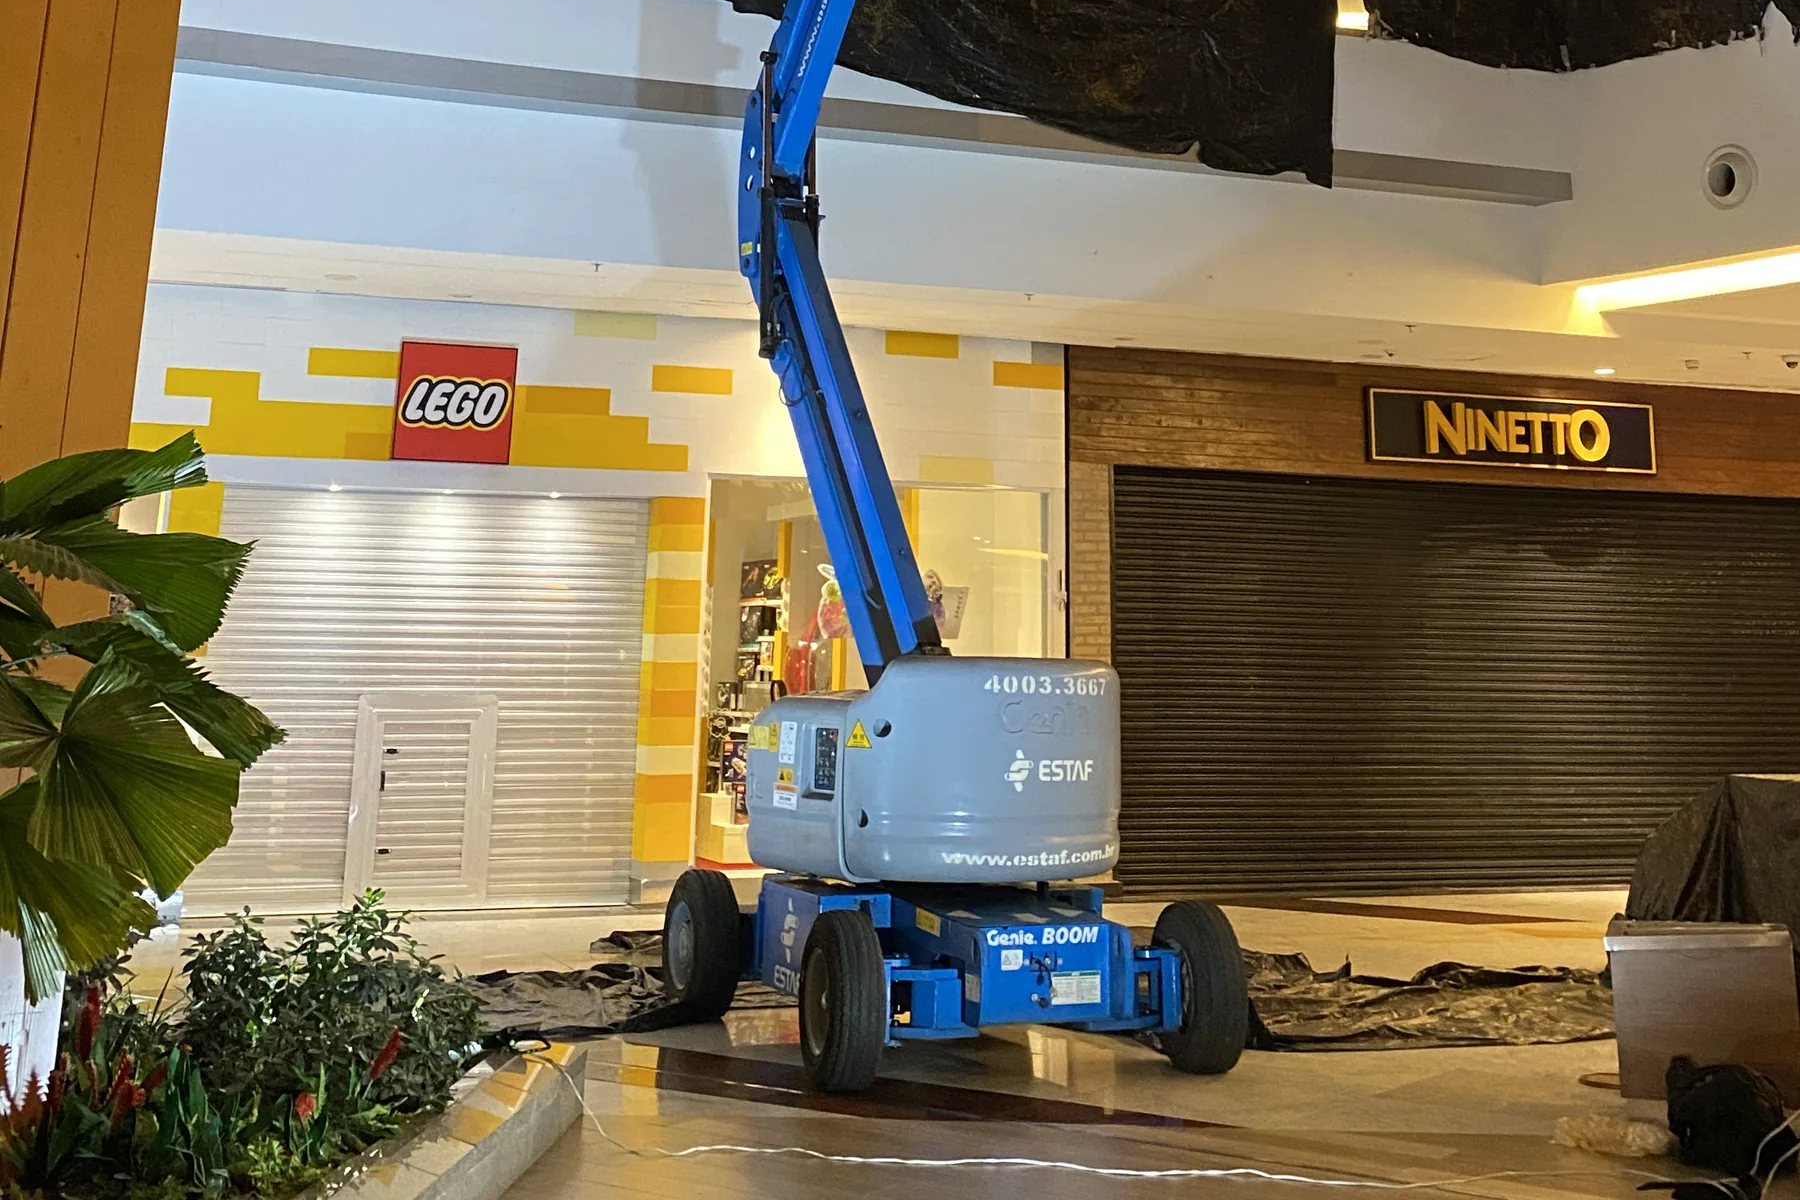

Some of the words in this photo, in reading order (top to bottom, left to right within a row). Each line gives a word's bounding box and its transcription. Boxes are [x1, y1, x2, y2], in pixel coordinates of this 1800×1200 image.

[401, 378, 509, 428] LEGO
[984, 674, 1107, 696] 4003.3667
[1038, 759, 1093, 782] ESTAF
[941, 844, 1116, 867] www.estaf.com.br
[1041, 926, 1099, 945] BOOM
